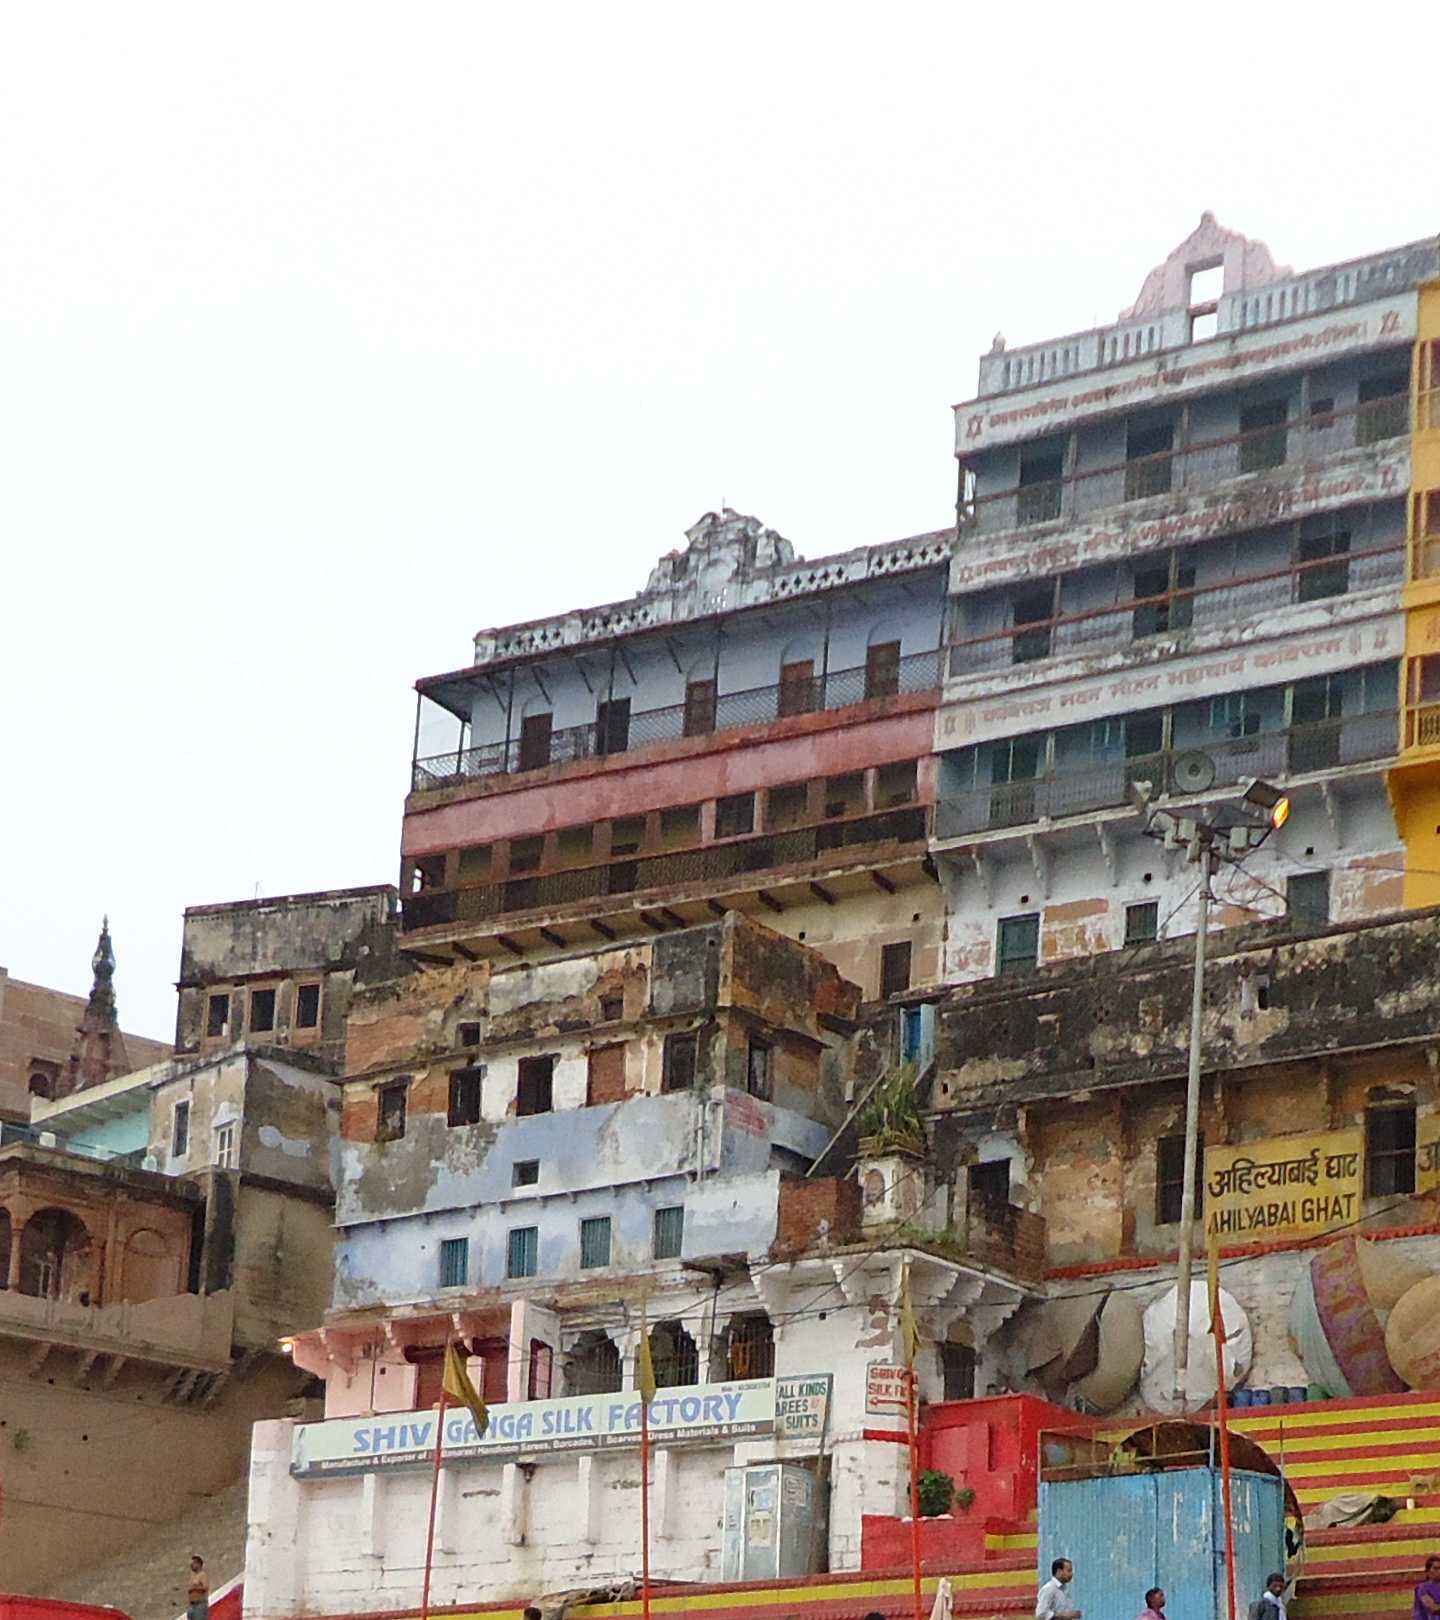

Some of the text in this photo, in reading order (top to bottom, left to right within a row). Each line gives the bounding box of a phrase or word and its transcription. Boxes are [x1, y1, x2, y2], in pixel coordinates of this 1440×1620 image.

[1208, 1149, 1358, 1197] अहिल्याबाई घाट
[1208, 1192, 1356, 1236] AHILYABAI GHAT
[778, 1384, 796, 1399] ALL
[798, 1381, 826, 1397] KINDS
[775, 1398, 809, 1417] AREES
[353, 1421, 433, 1453] SHIV
[542, 1406, 593, 1435] SILK
[607, 1391, 744, 1431] FACTORY
[785, 1413, 819, 1430] SUITS
[606, 1433, 642, 1444] Scarves
